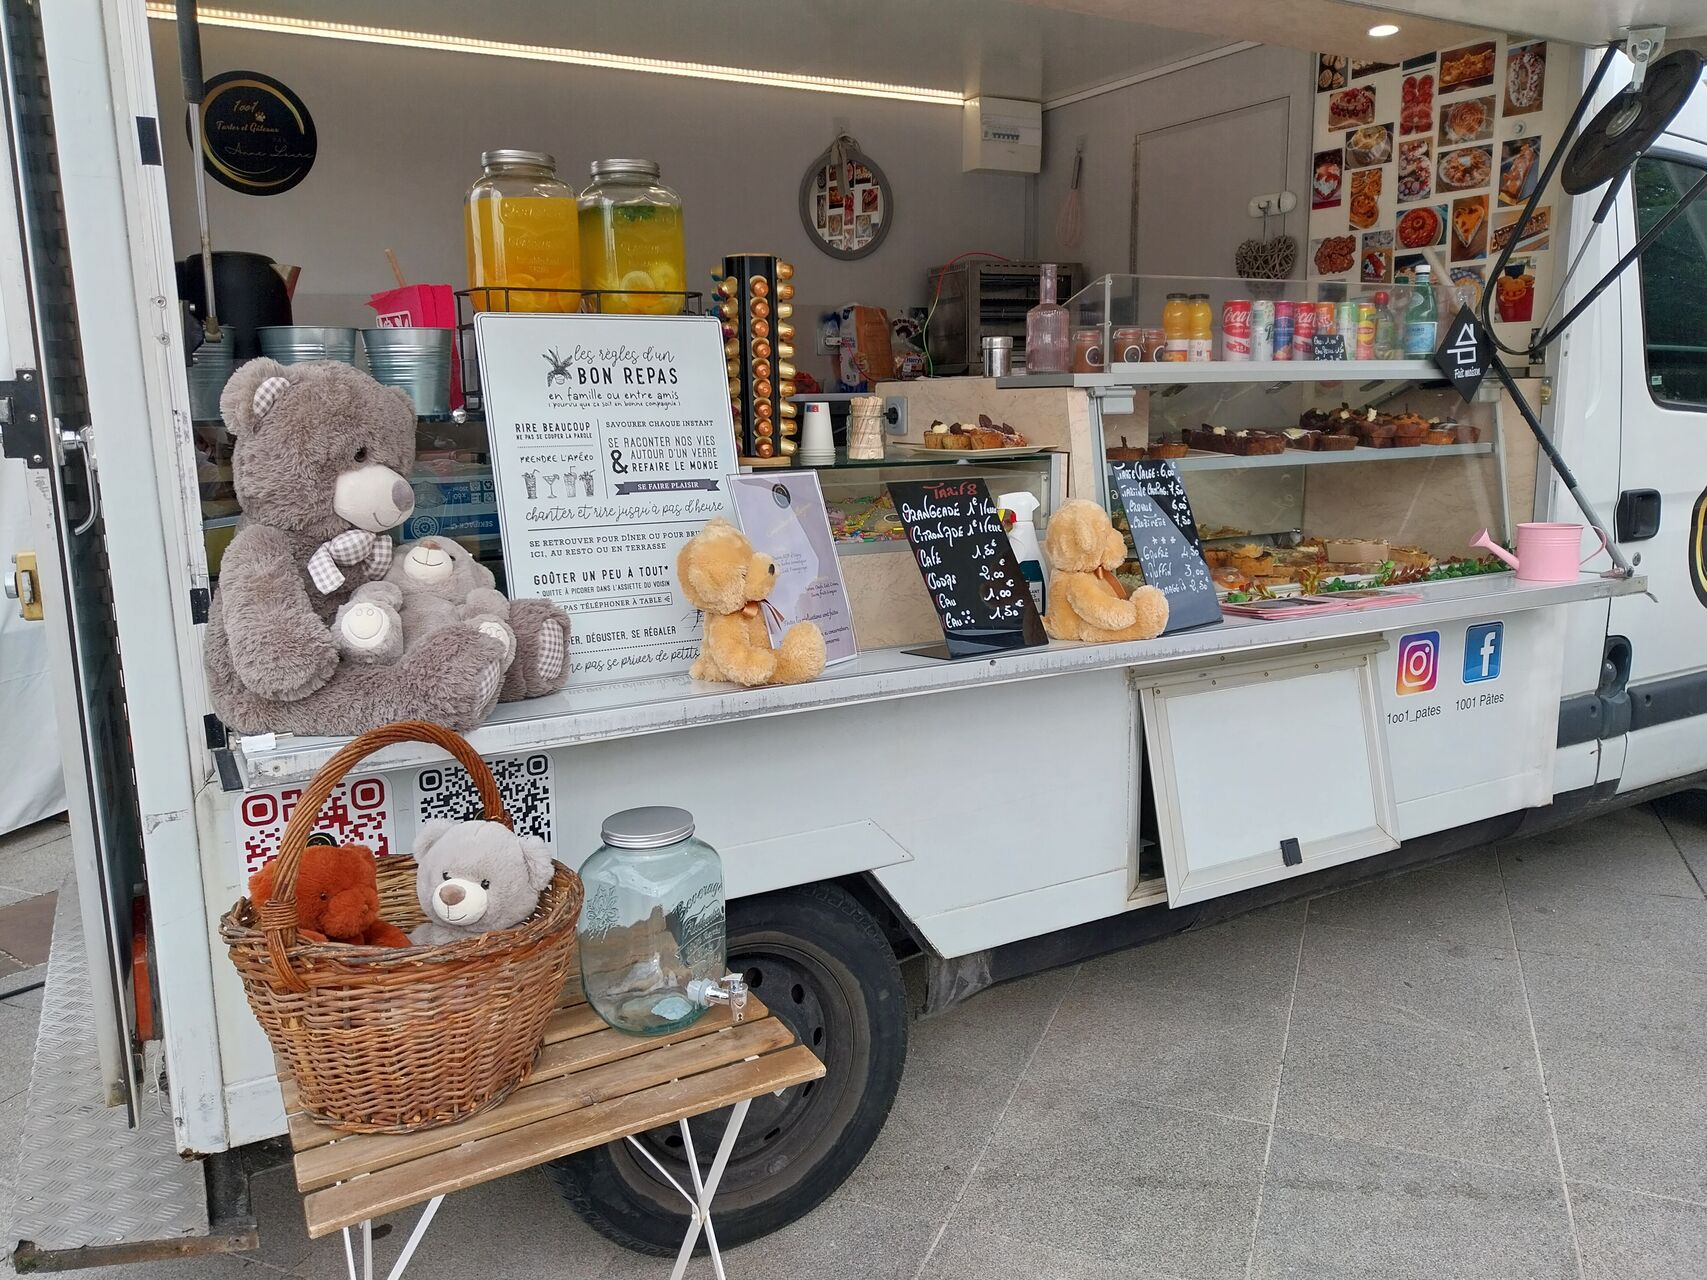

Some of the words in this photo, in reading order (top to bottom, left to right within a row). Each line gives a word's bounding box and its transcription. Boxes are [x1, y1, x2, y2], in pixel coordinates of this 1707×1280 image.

[574, 344, 595, 364] les
[599, 345, 639, 367] règles
[642, 345, 675, 363] d'un
[577, 367, 612, 384] BON
[623, 367, 678, 384] REPAS
[567, 387, 602, 401] famille
[624, 391, 652, 399] entre
[657, 391, 679, 399] amis
[515, 423, 537, 433] RIRE
[543, 422, 590, 432] BEAUCOUP
[608, 437, 619, 448] SE
[624, 436, 671, 448] RACONTER
[675, 436, 692, 446] NOS
[696, 435, 715, 446] VIES
[520, 454, 557, 463] PRENDRE
[561, 451, 594, 462] L'APÉRO
[611, 449, 628, 474] &
[631, 448, 664, 460] AUTOUR
[669, 448, 687, 458] D'UN
[692, 447, 717, 458] VERRE
[632, 461, 670, 472] REFAIRE
[674, 461, 684, 471] LE
[690, 460, 718, 470] MONDE
[649, 482, 670, 490] FAIRE
[671, 481, 699, 489] PLAISIR
[525, 506, 575, 522] chanter
[577, 504, 593, 520] et
[593, 504, 616, 518] rire
[615, 501, 659, 522] jusqu'à
[662, 504, 682, 517] pas
[685, 499, 724, 513] d'heure
[529, 540, 541, 548] SE
[543, 537, 595, 547] RETROUVER
[596, 534, 625, 543] POUR
[626, 532, 647, 542] DÎNER
[648, 532, 661, 540] OU
[663, 531, 685, 539] POUR
[530, 551, 548, 559] ICI,
[550, 549, 562, 557] AU
[565, 547, 594, 556] RESTO
[596, 546, 609, 554] OU
[626, 542, 667, 552] TERRASSE
[533, 571, 576, 586] GOÛTER
[583, 570, 596, 582] UN
[602, 568, 622, 580] PEU
[627, 566, 634, 578] À
[542, 589, 562, 597] QUITTE
[565, 587, 569, 595] À
[571, 586, 595, 595] PICORER
[596, 585, 611, 593] DANS
[613, 582, 642, 591] L'ASSIETTE
[653, 580, 670, 588] VOISIN
[563, 604, 578, 612] PAS
[580, 600, 631, 610] TÉLÉPHONER
[632, 597, 639, 606] À
[640, 596, 662, 604] TABLE
[586, 629, 628, 644] DÉGUSTER,
[632, 629, 641, 639] SE
[644, 625, 677, 637] RÉGALER
[585, 659, 605, 673] pas
[607, 657, 619, 671] se
[621, 650, 653, 668] priver
[656, 650, 669, 662] de
[670, 645, 700, 660] petits
[1455, 696, 1477, 711] 1001
[1479, 692, 1505, 707] Pâtes
